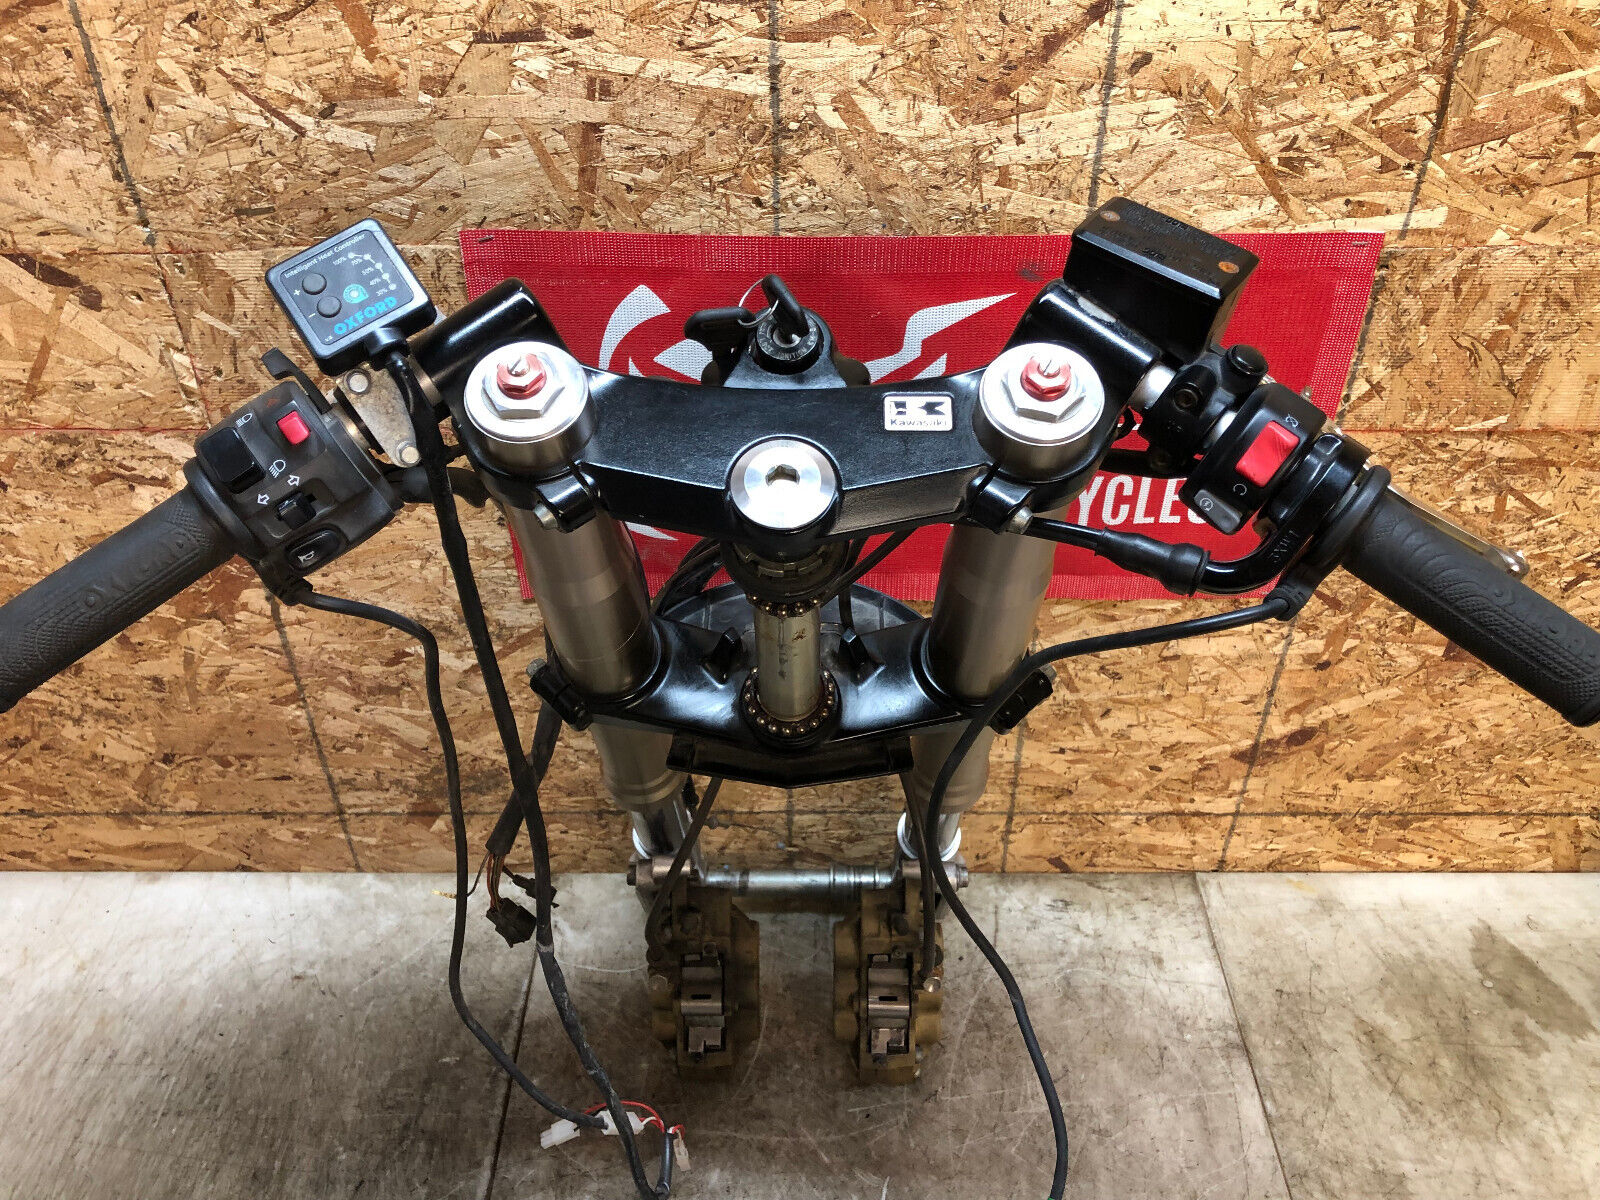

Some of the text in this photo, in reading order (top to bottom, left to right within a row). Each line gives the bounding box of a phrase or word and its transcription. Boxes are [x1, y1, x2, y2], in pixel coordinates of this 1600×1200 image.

[284, 234, 366, 279] Intelligent Heat Controller
[332, 256, 347, 266] 100%
[361, 266, 375, 276] 50%
[375, 287, 389, 297] 30%
[334, 297, 397, 335] OXFORD
[890, 418, 948, 427] Kawasaki
